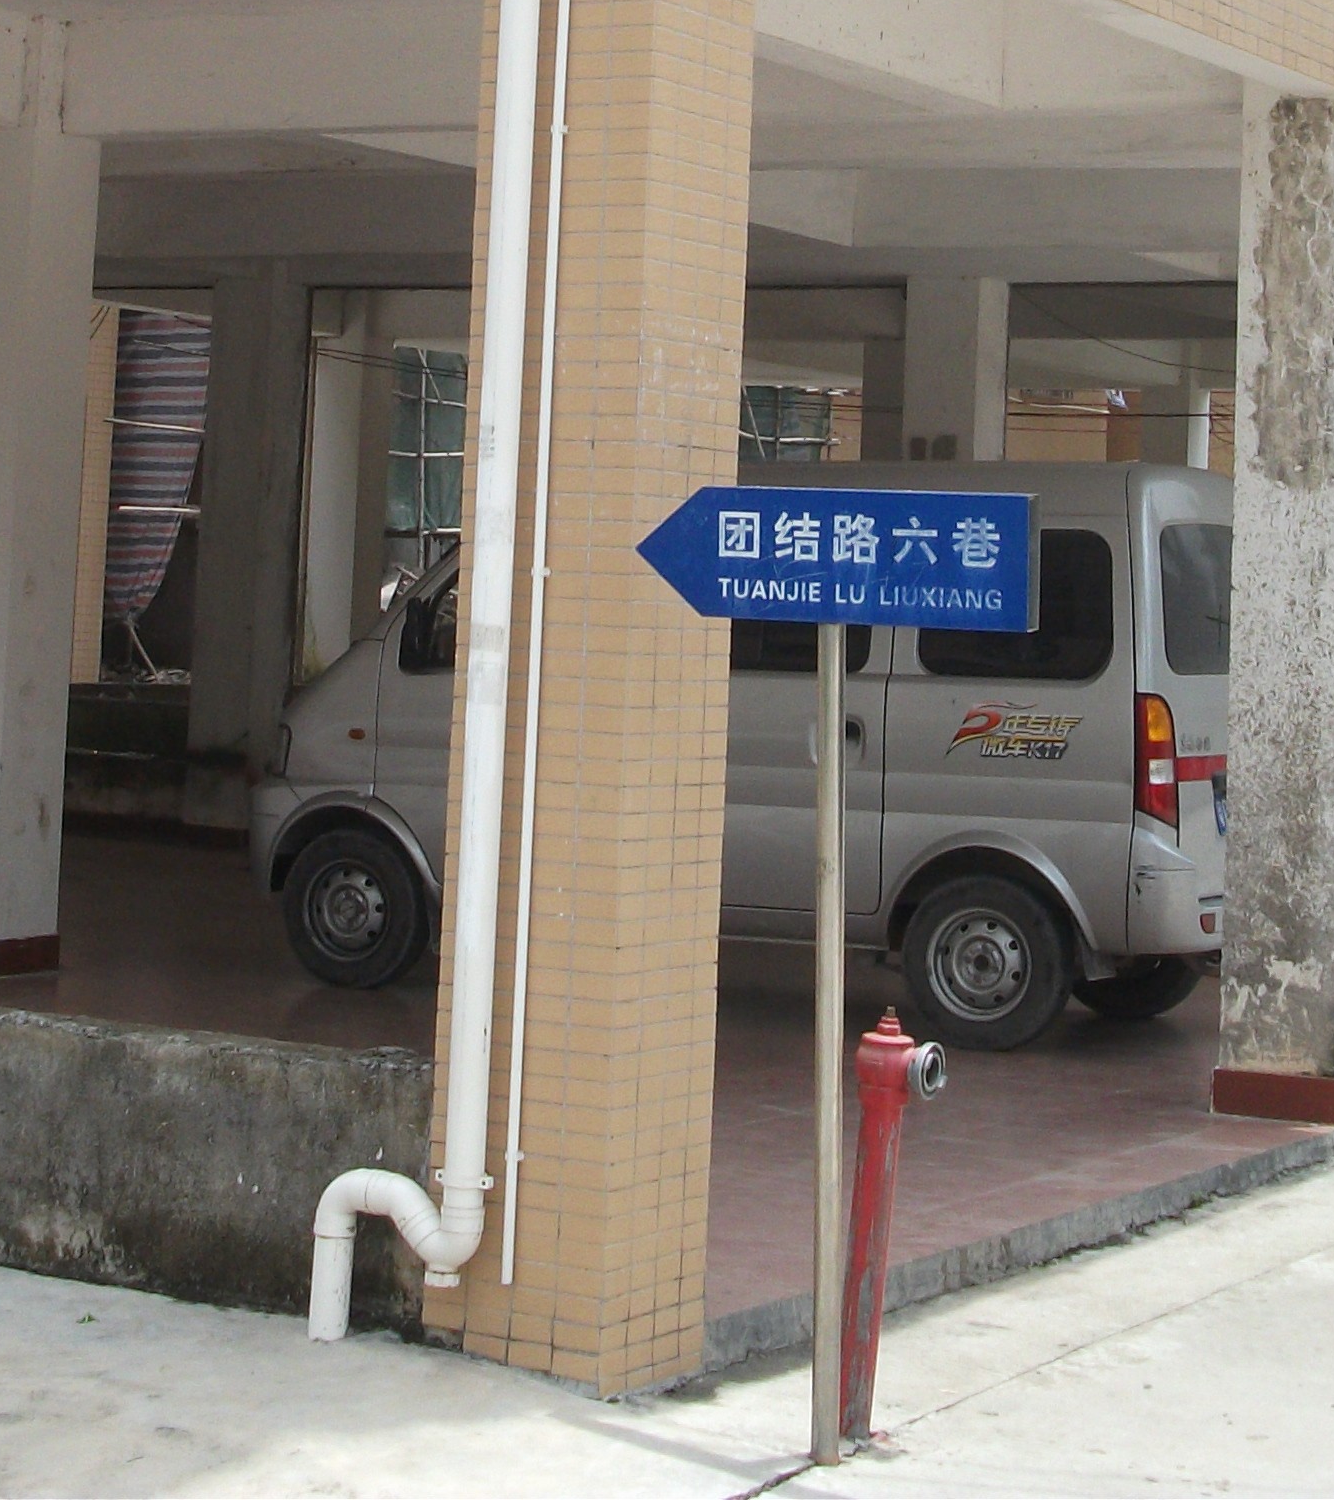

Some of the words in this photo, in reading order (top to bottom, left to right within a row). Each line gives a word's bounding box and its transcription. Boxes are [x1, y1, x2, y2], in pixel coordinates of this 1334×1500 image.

[718, 511, 1001, 568] 团结路六巷
[718, 578, 821, 603] TUANJIE
[835, 583, 865, 605] LU
[880, 585, 1003, 610] LIUXIANG
